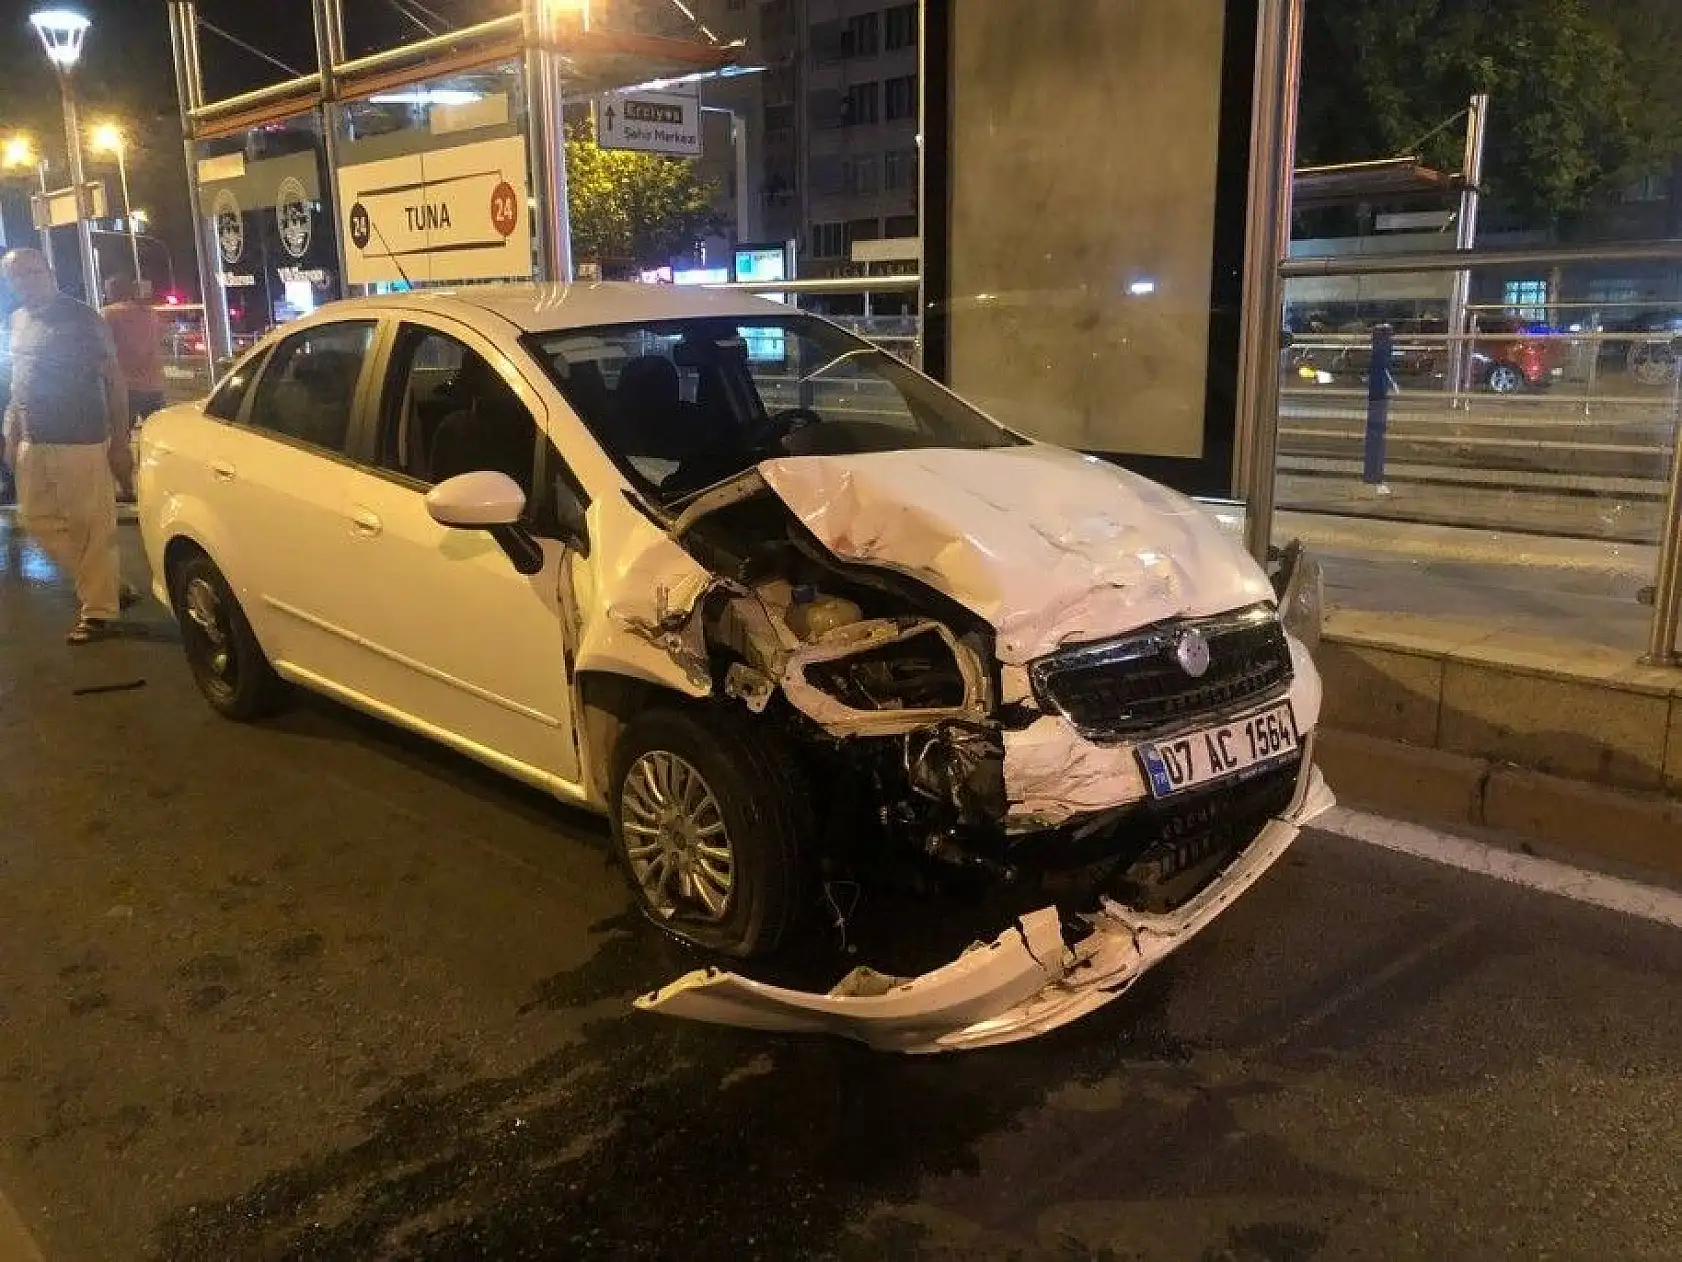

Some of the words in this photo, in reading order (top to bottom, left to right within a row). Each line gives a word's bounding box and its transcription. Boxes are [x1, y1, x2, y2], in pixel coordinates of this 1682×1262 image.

[405, 201, 451, 232] TUNA
[494, 197, 513, 222] 24
[353, 216, 367, 237] 24
[1160, 740, 1193, 784] 07
[1204, 729, 1238, 773] AC
[1245, 708, 1291, 759] 1564
